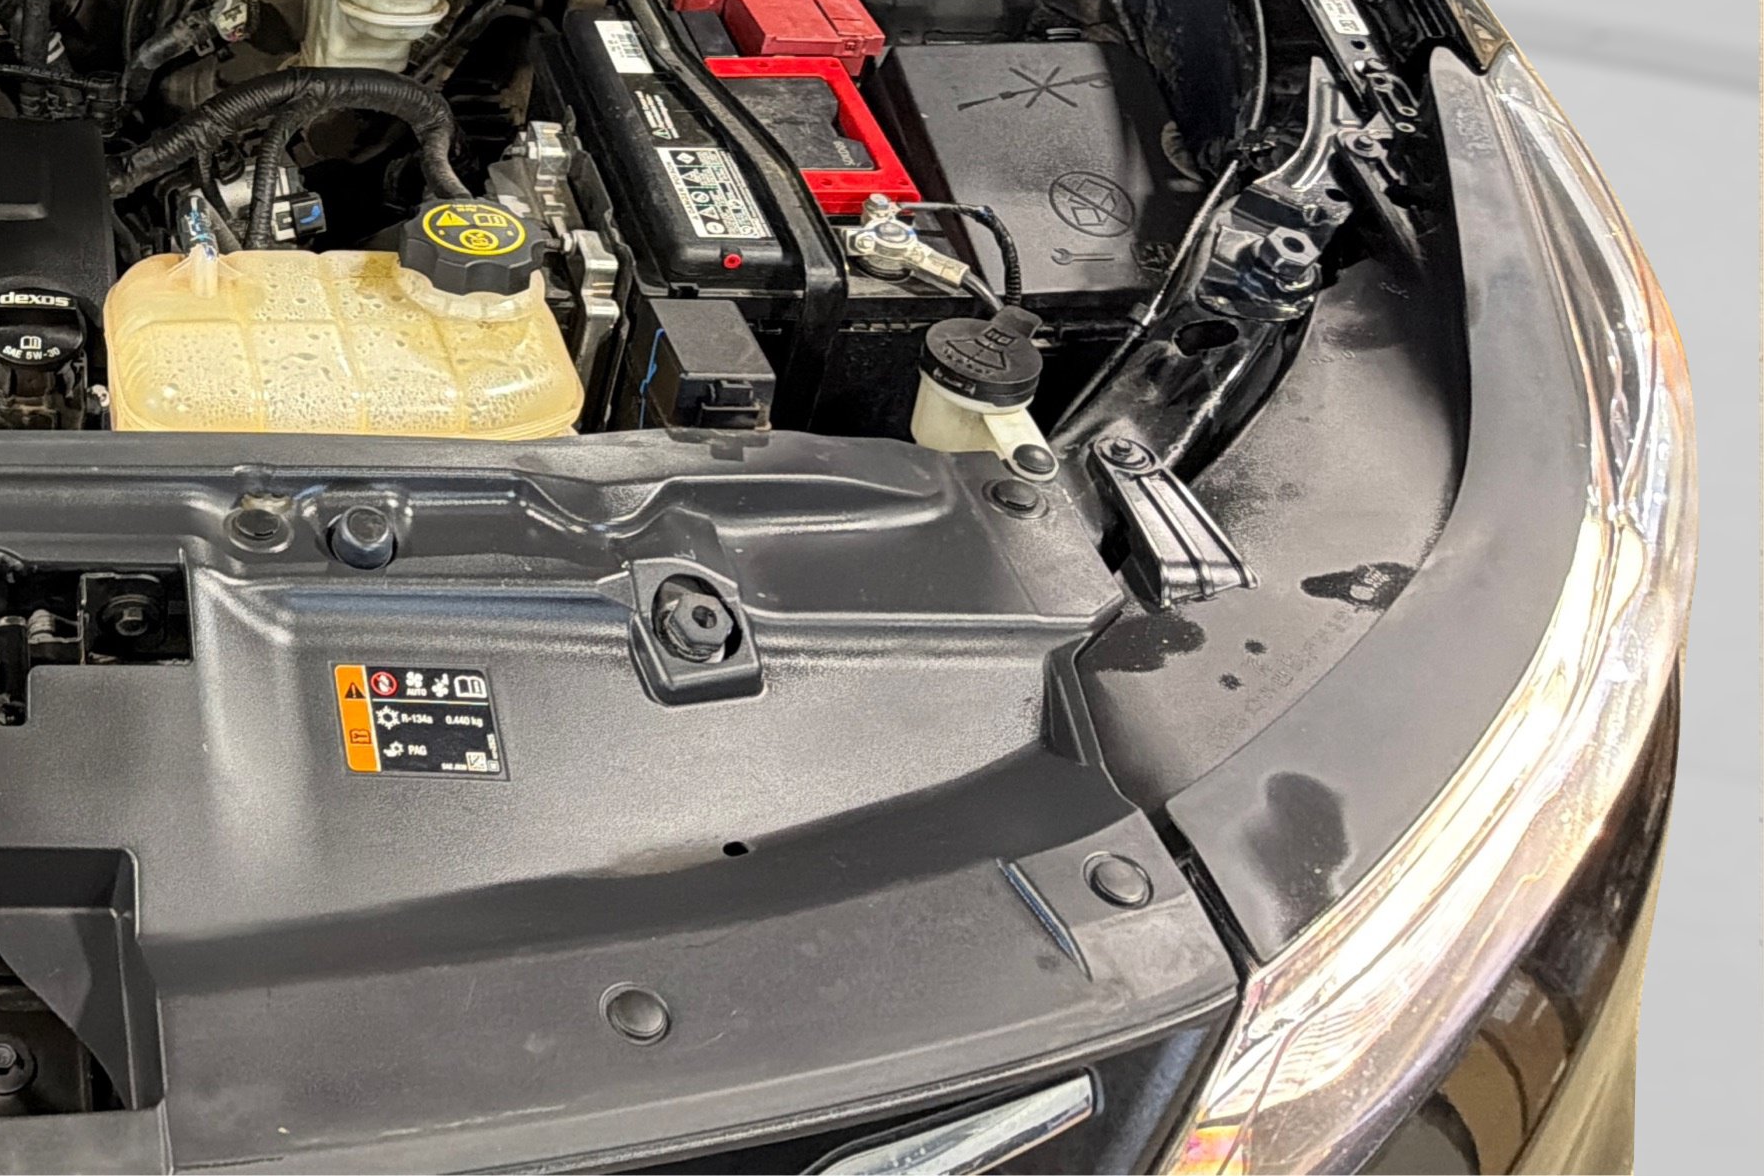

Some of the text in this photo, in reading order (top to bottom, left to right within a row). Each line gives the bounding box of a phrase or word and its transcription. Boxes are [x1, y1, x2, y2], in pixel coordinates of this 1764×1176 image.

[0, 291, 71, 307] dexos
[2, 345, 61, 360] SAE 5W-30
[406, 687, 427, 696] AUTO
[401, 713, 434, 724] R-134a
[471, 716, 484, 728] kg
[408, 744, 428, 756] PAG
